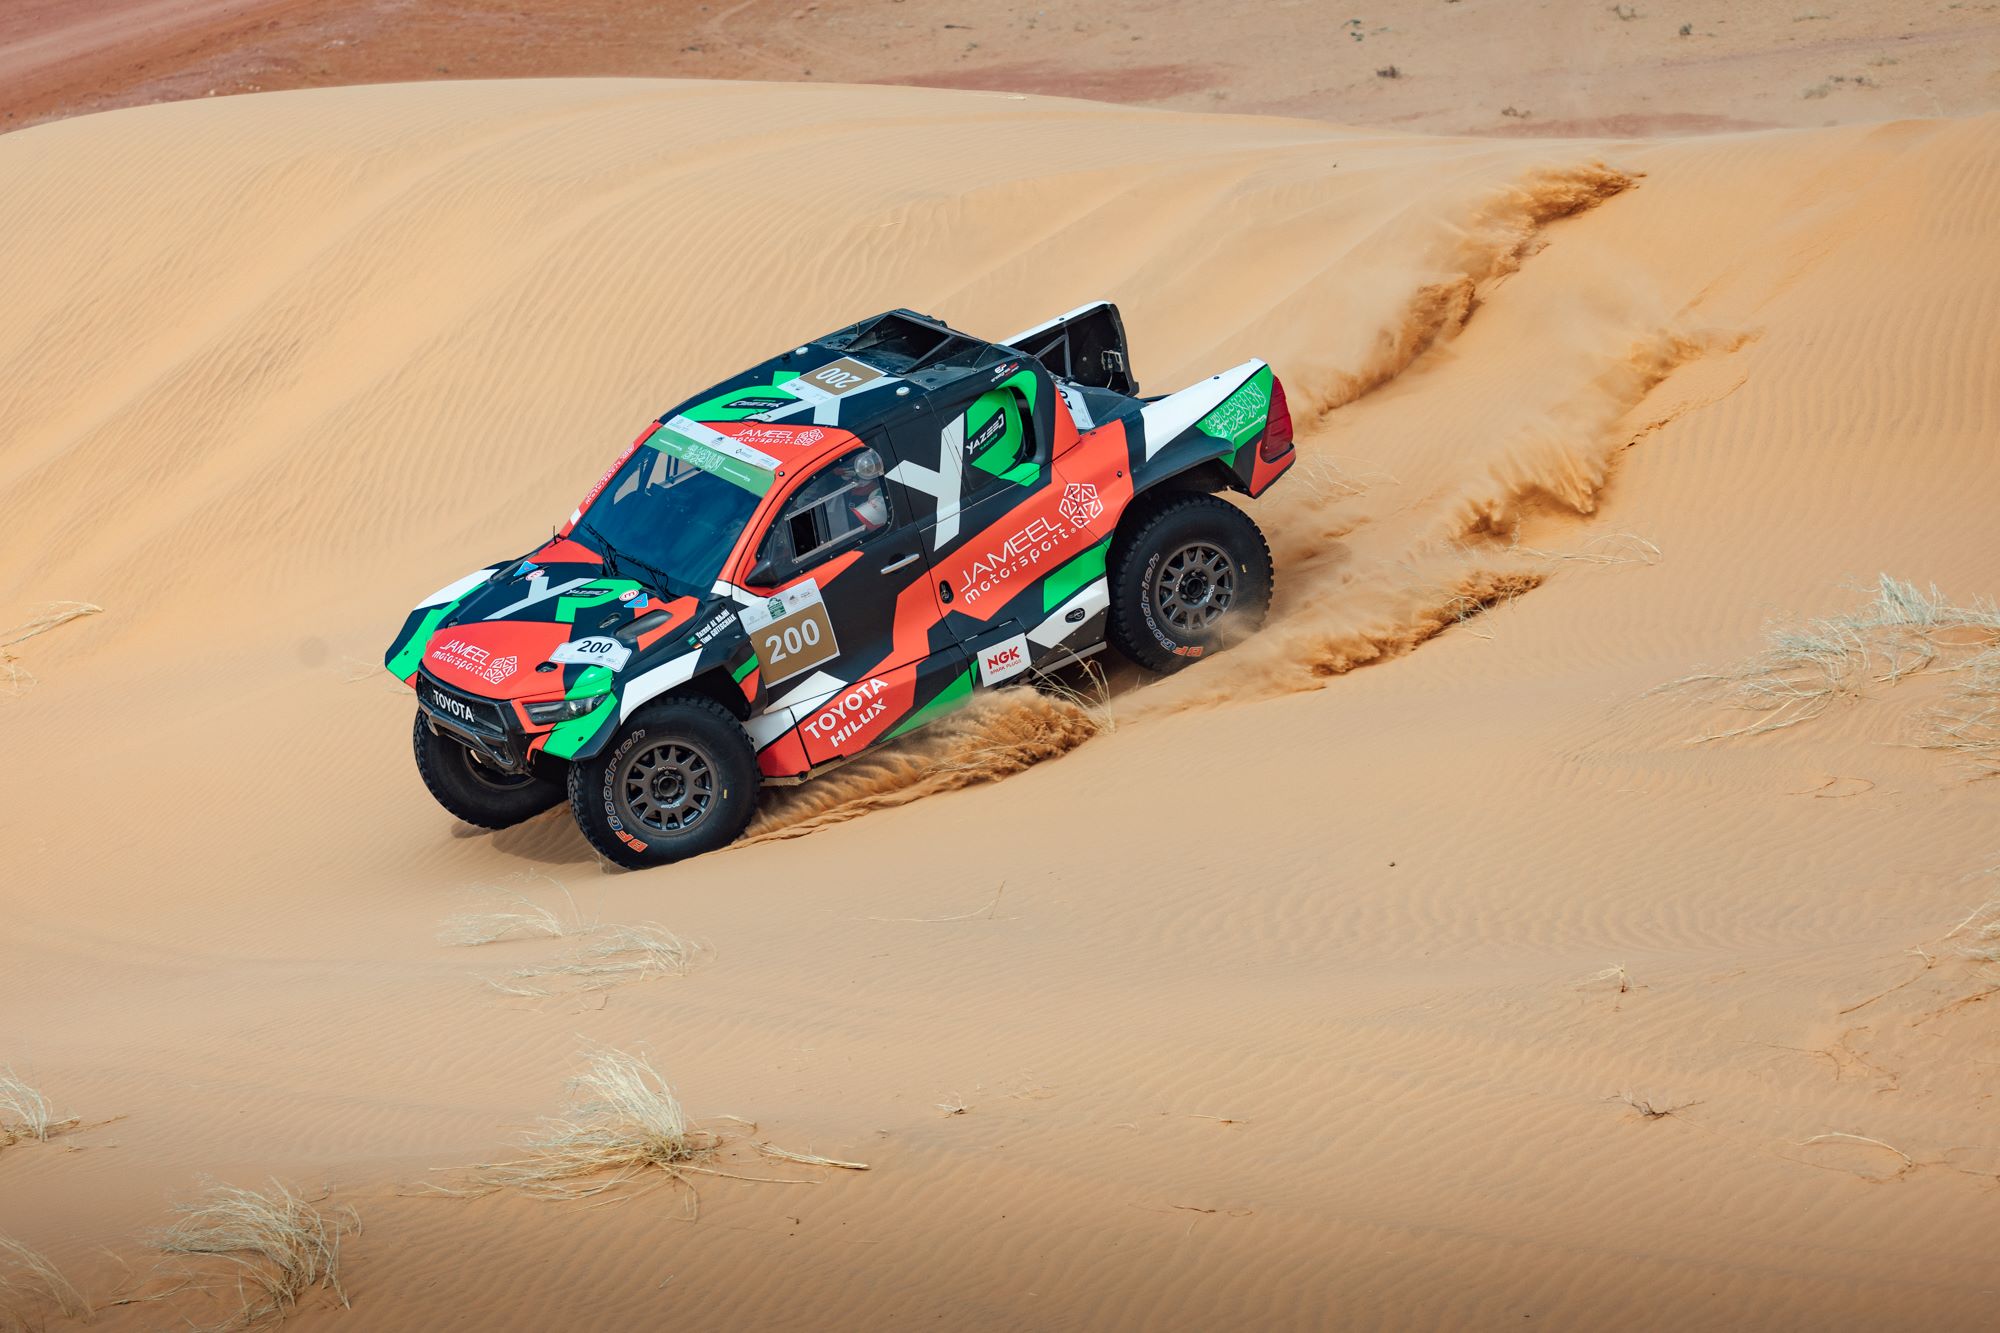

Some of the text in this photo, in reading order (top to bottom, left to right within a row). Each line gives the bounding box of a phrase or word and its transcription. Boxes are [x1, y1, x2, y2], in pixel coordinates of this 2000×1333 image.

[815, 367, 863, 389] 200
[731, 429, 793, 439] JAMEEL
[965, 413, 1004, 455] YAZEED
[960, 517, 1062, 592] JAMEEL
[964, 527, 1069, 604] motorsport
[1140, 552, 1204, 657] BFGoodrich
[439, 640, 490, 666] JAMEEL
[576, 640, 613, 654] 200
[765, 618, 820, 665] 200
[987, 645, 1021, 670] NGK
[431, 650, 483, 676] motorsport
[432, 689, 475, 722] TOYOTA
[804, 678, 889, 740] TOYOTA
[830, 698, 887, 748] HILUX
[603, 728, 649, 853] BFGoodrich
